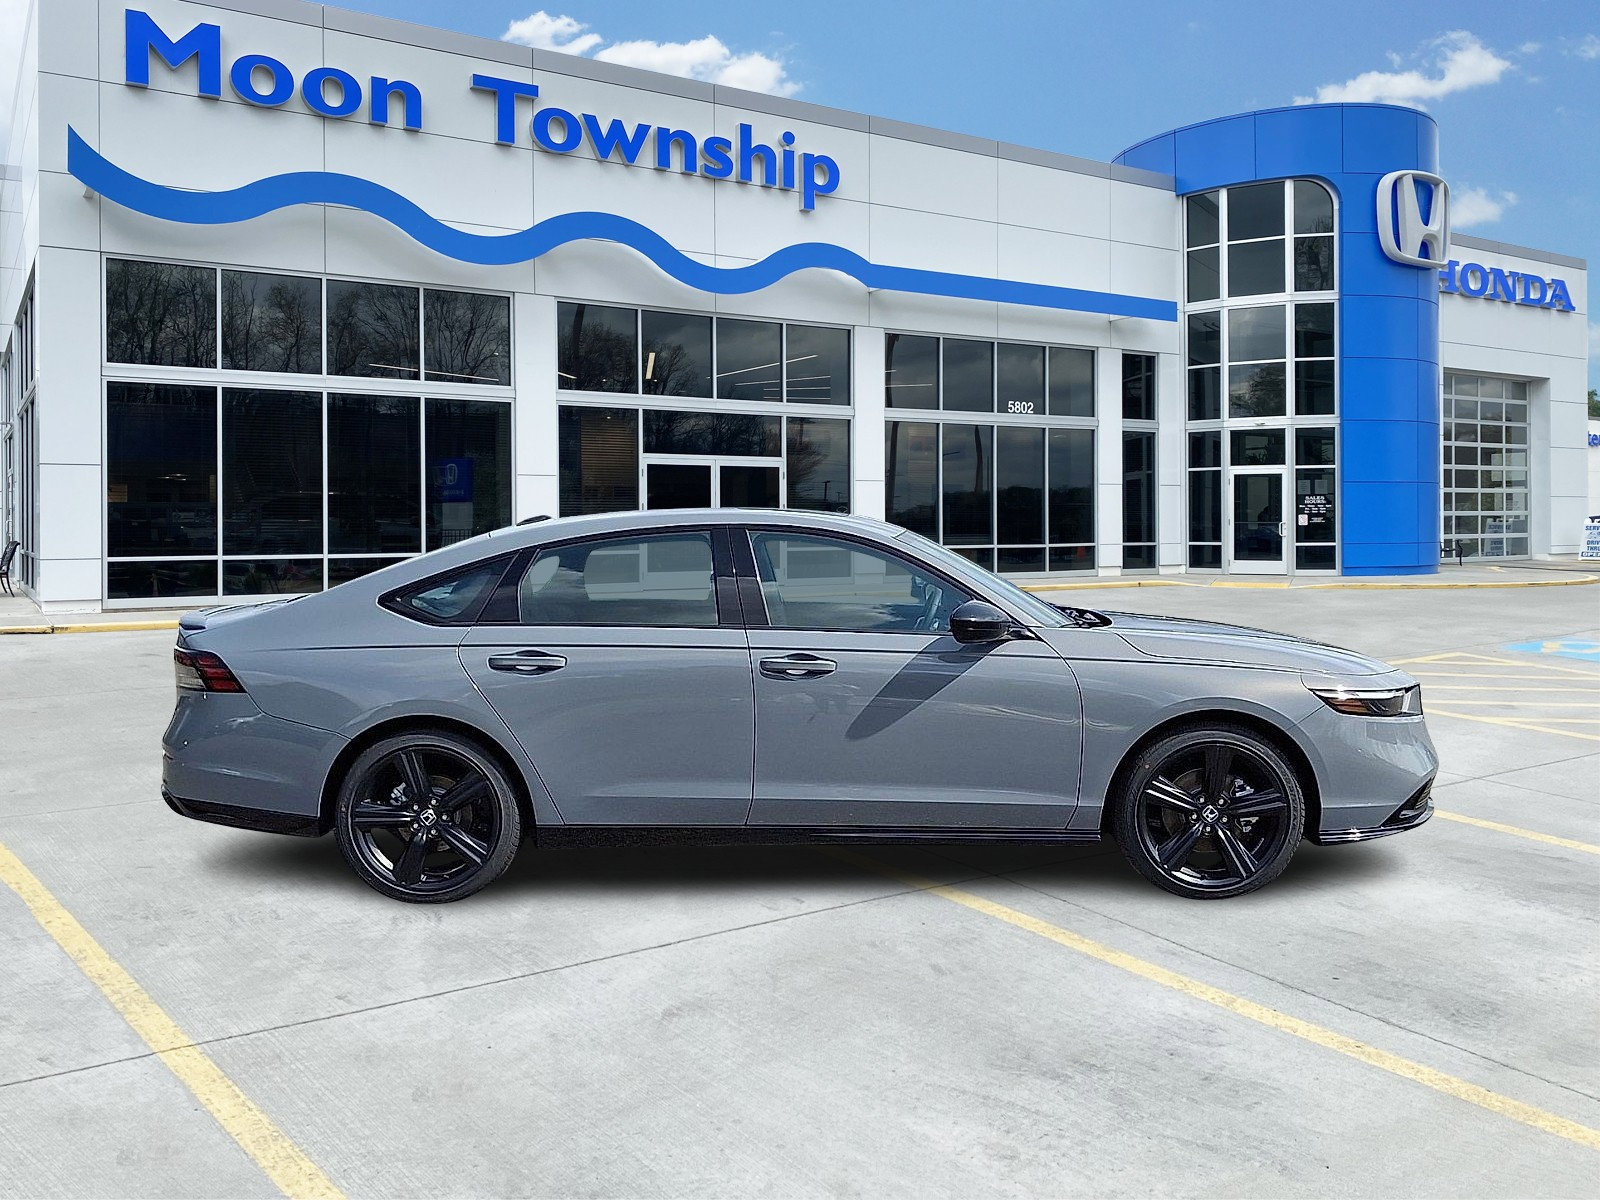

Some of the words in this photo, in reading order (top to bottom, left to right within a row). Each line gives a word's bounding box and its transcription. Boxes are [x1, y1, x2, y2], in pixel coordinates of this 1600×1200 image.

[125, 8, 423, 132] Moon
[469, 73, 842, 213] Township
[1007, 400, 1034, 414] 5802
